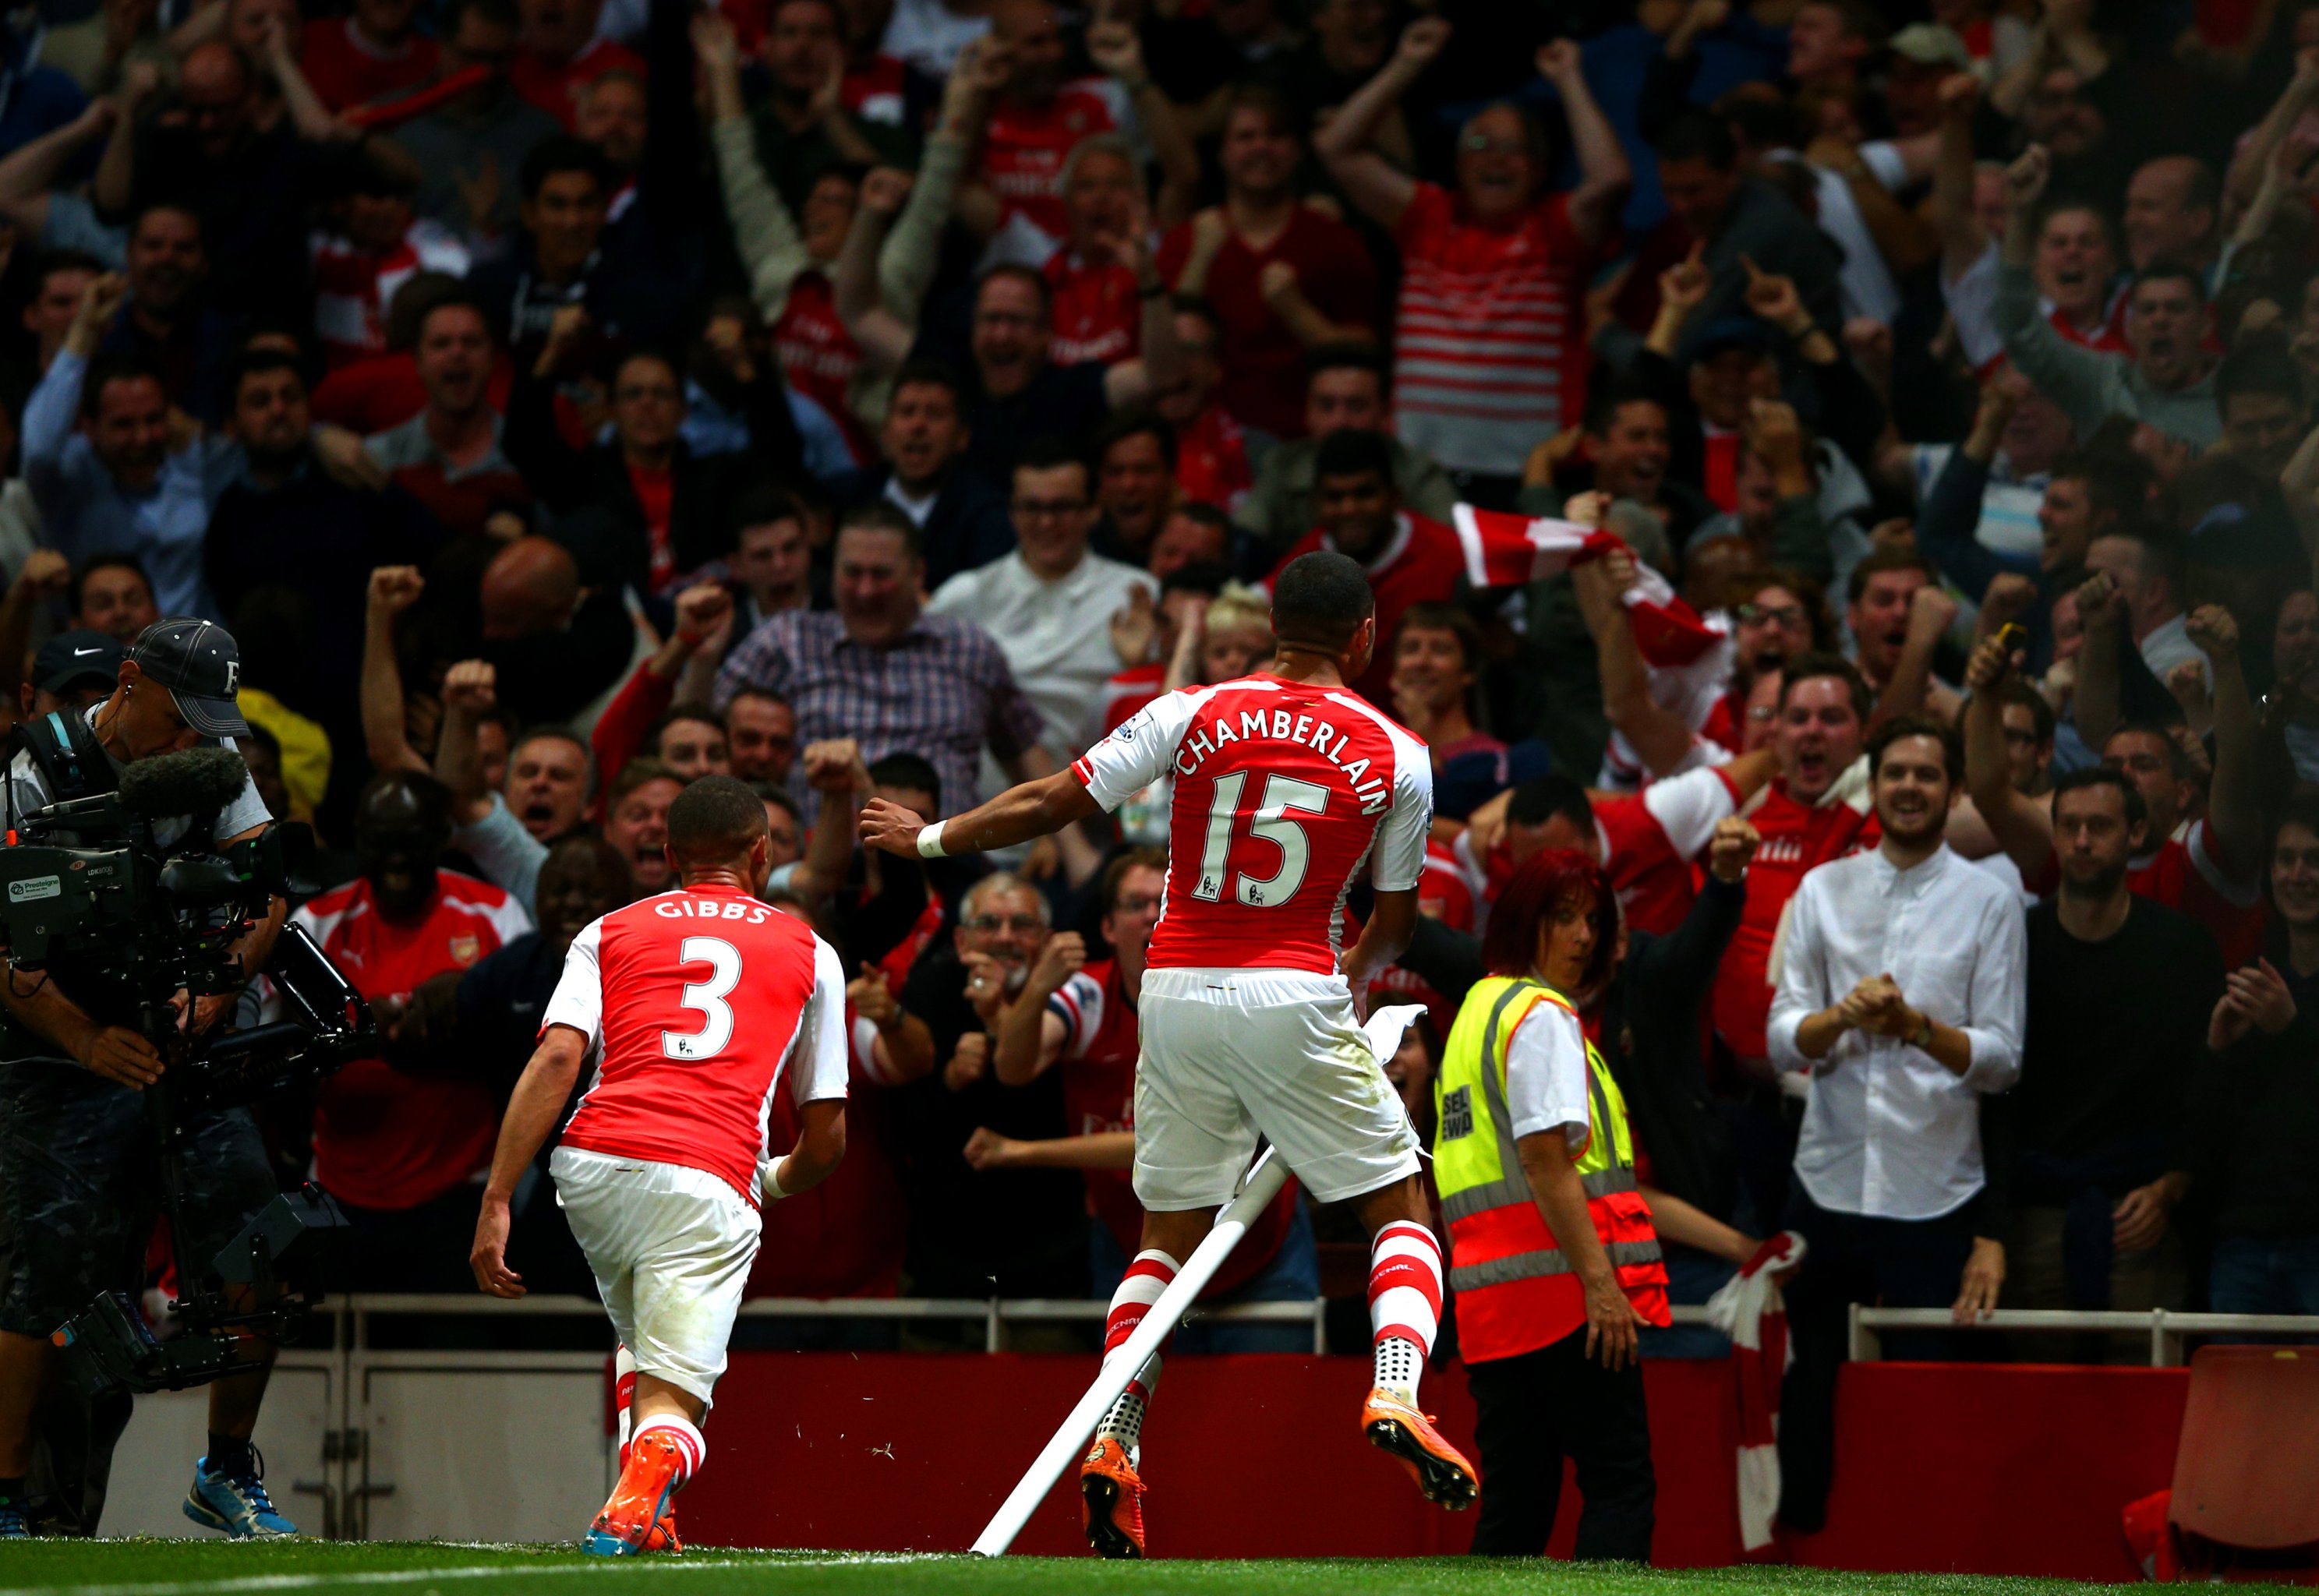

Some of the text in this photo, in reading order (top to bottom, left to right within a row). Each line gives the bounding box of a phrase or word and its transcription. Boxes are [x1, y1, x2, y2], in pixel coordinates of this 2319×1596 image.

[224, 660, 239, 694] F
[1175, 708, 1388, 816] CHAMBERLAIN
[1191, 770, 1331, 907] 15
[24, 879, 59, 889] Presteigne
[655, 901, 772, 924] GIBBS
[661, 936, 743, 1061] 3
